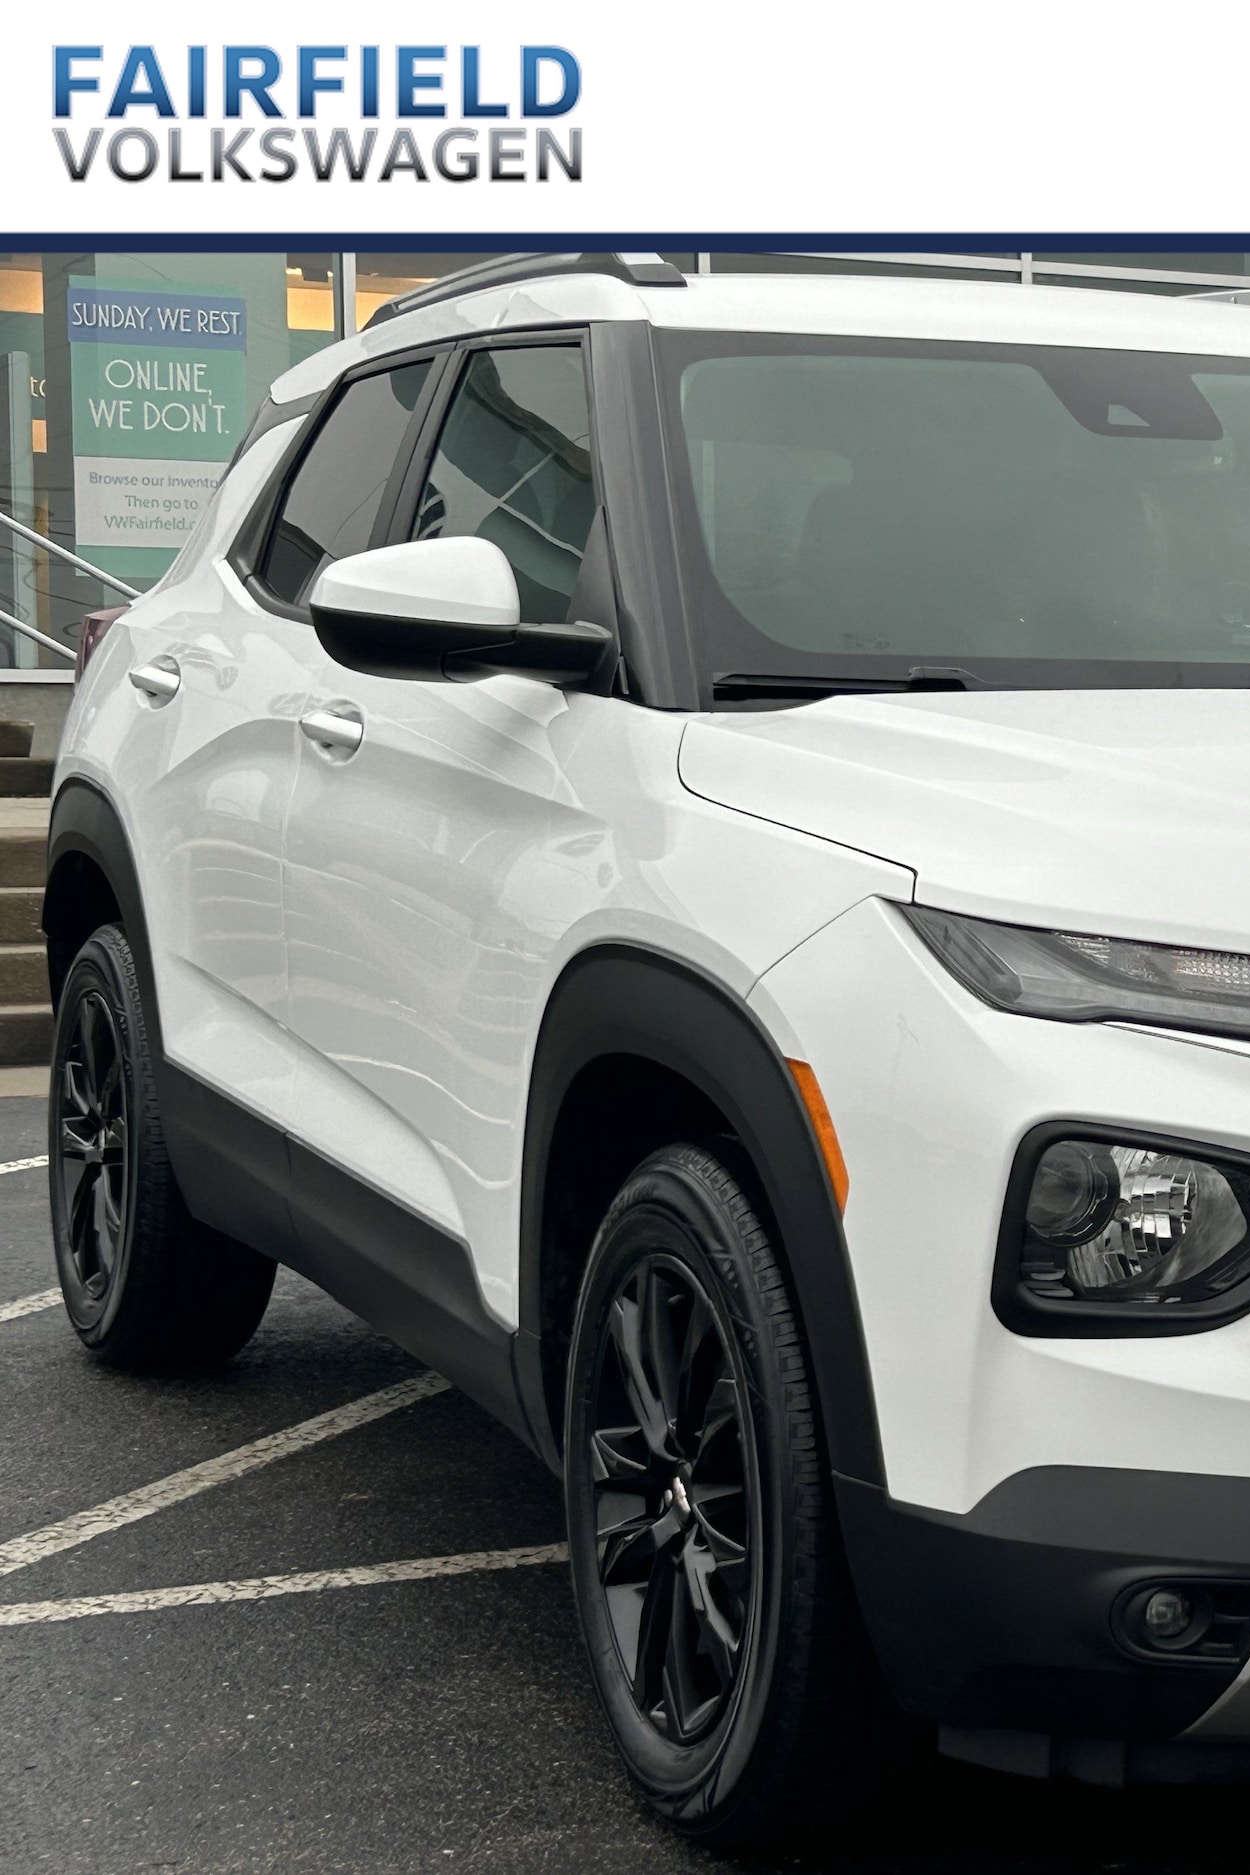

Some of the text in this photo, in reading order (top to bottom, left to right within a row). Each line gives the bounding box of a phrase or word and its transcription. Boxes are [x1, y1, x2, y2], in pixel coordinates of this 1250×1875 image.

[157, 307, 191, 332] WE
[105, 359, 212, 396] ONLINE,
[89, 397, 229, 434] WE DON'T.
[89, 472, 138, 486] Browse
[141, 475, 164, 488] our
[124, 495, 198, 512] Then go to
